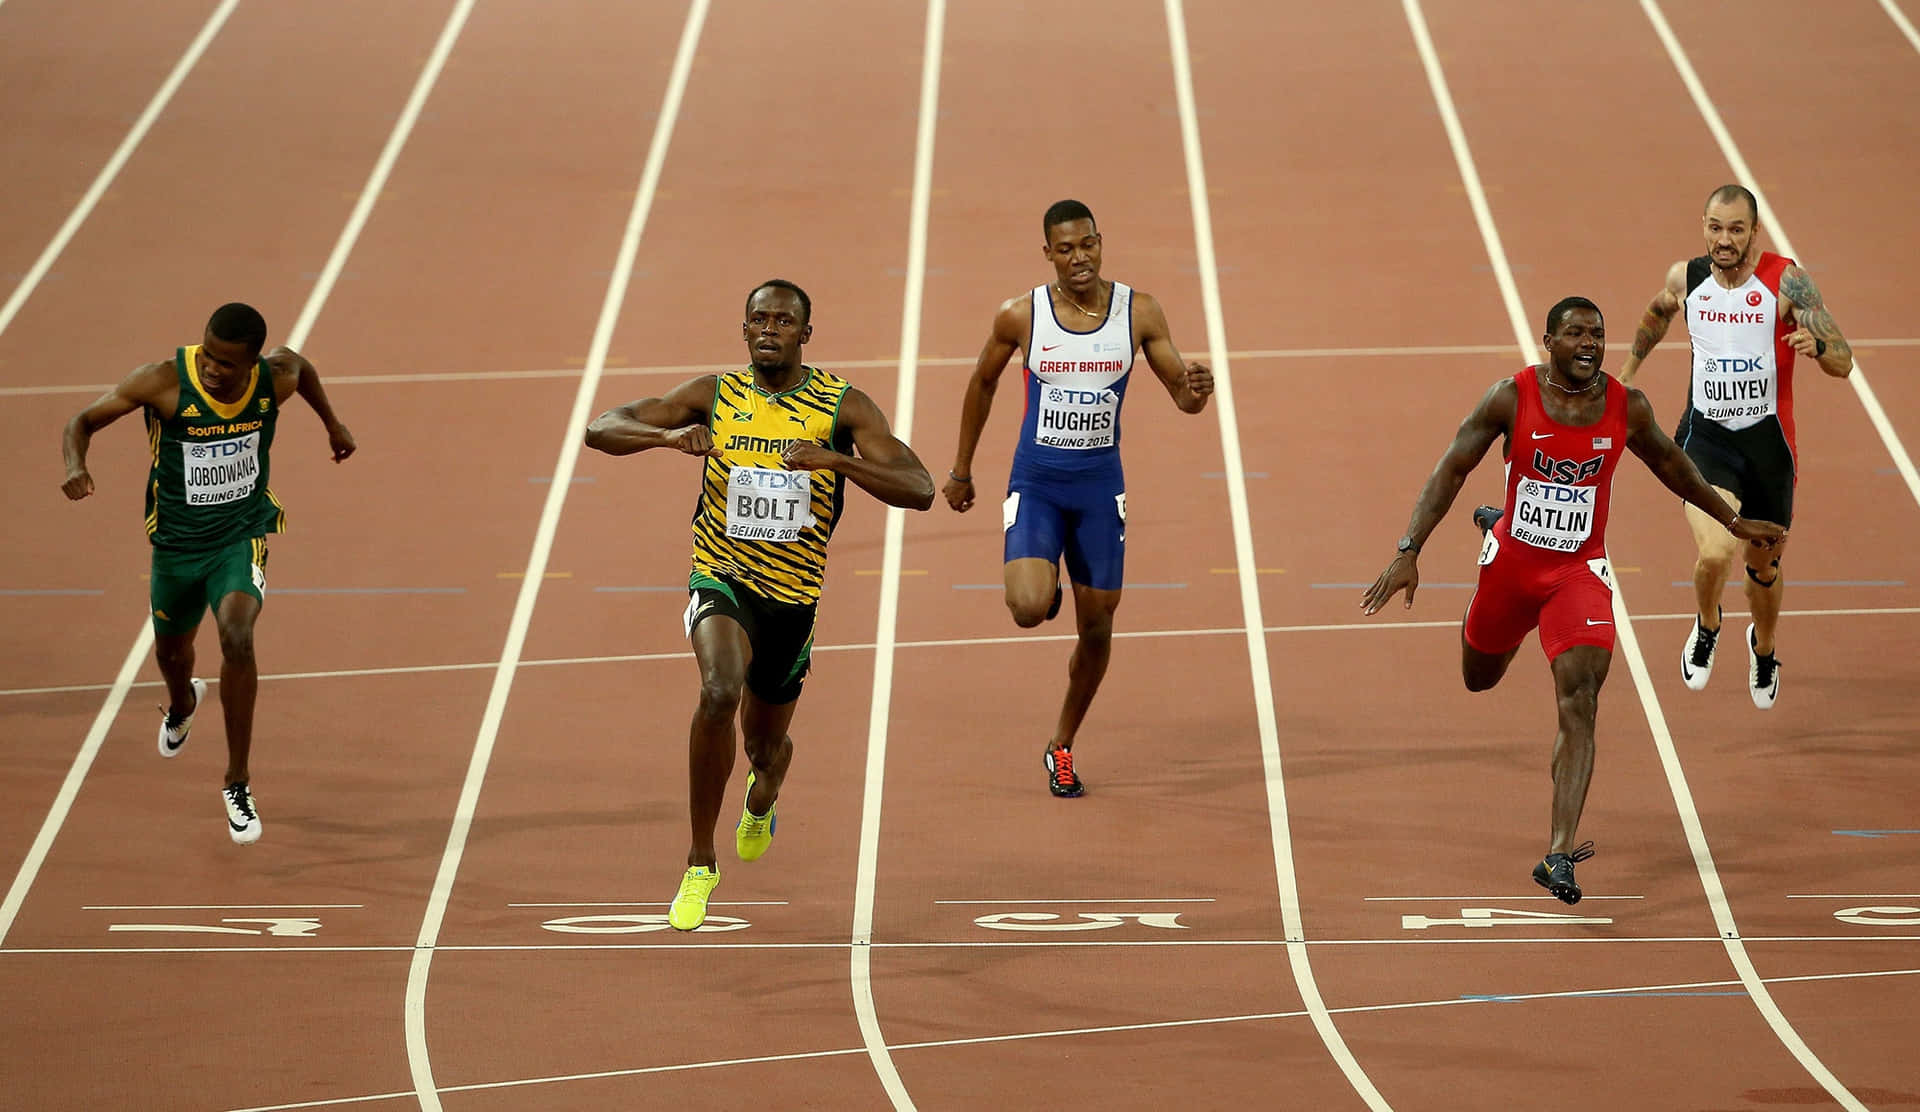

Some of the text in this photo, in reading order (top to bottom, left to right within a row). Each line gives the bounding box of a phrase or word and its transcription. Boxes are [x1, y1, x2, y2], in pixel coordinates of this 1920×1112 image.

[1699, 309, 1765, 324] TÜRKİYE
[1040, 360, 1123, 373] GREAT BRITAIN
[1717, 356, 1764, 373] TDK
[1063, 390, 1111, 406] TDK
[1704, 378, 1769, 401] GULIYEV
[1746, 403, 1769, 416] 2015
[187, 420, 263, 437] SOUTH AFRICA
[1043, 408, 1111, 431] HUGHES
[205, 437, 253, 458] TDK
[1041, 435, 1111, 448] BEIJING 2015
[187, 456, 257, 487] JOBODWANA
[1532, 448, 1605, 486] USA
[753, 470, 804, 490] TDK
[191, 490, 235, 503] BEIJING
[1540, 485, 1589, 504] TDK
[737, 495, 800, 522] BOLT
[1519, 501, 1588, 532] GATLIN
[730, 524, 800, 540] BEIJING 201
[1515, 528, 1558, 548] BEIJING
